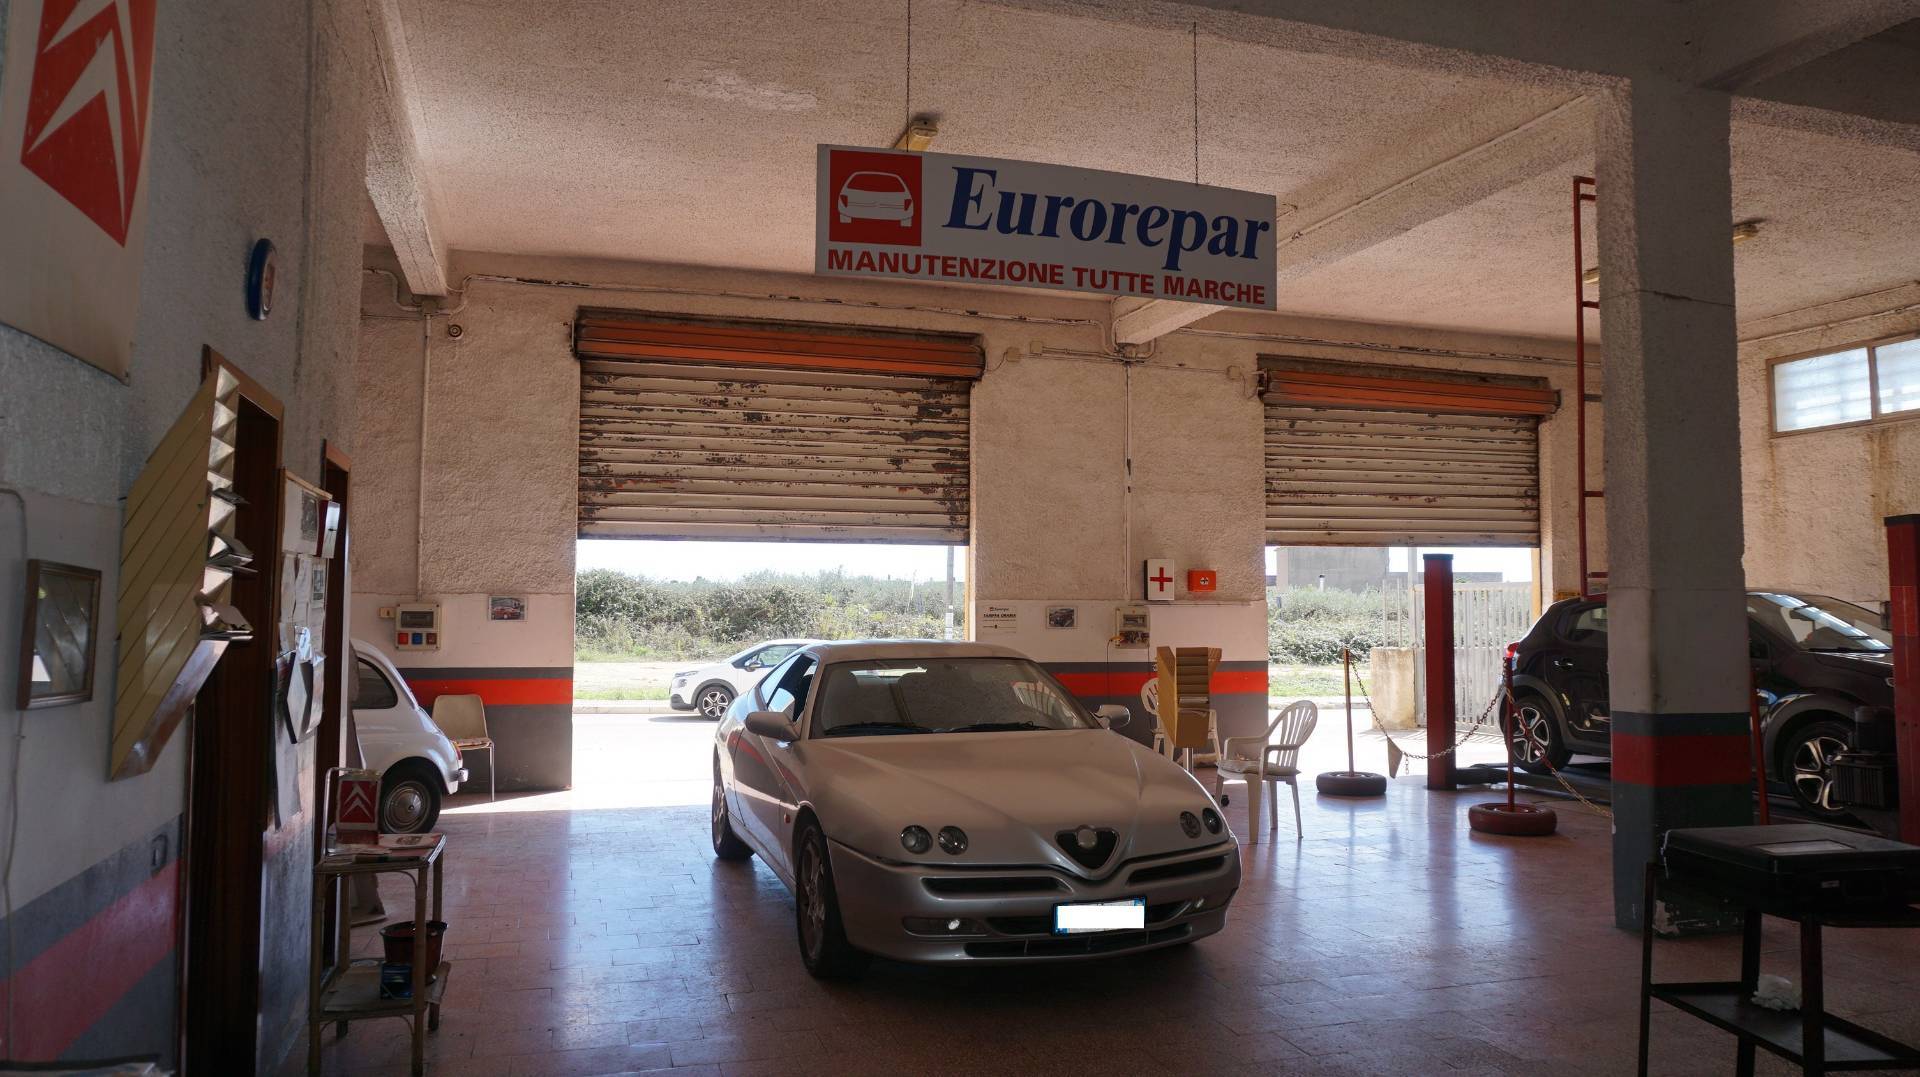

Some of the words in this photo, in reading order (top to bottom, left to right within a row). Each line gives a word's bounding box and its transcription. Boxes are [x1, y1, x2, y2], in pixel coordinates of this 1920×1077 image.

[941, 166, 1270, 271] Eurorepar
[828, 249, 1064, 285] MANUTENZIONE
[1072, 266, 1154, 295] TUTTE
[1163, 275, 1265, 305] MARCHE
